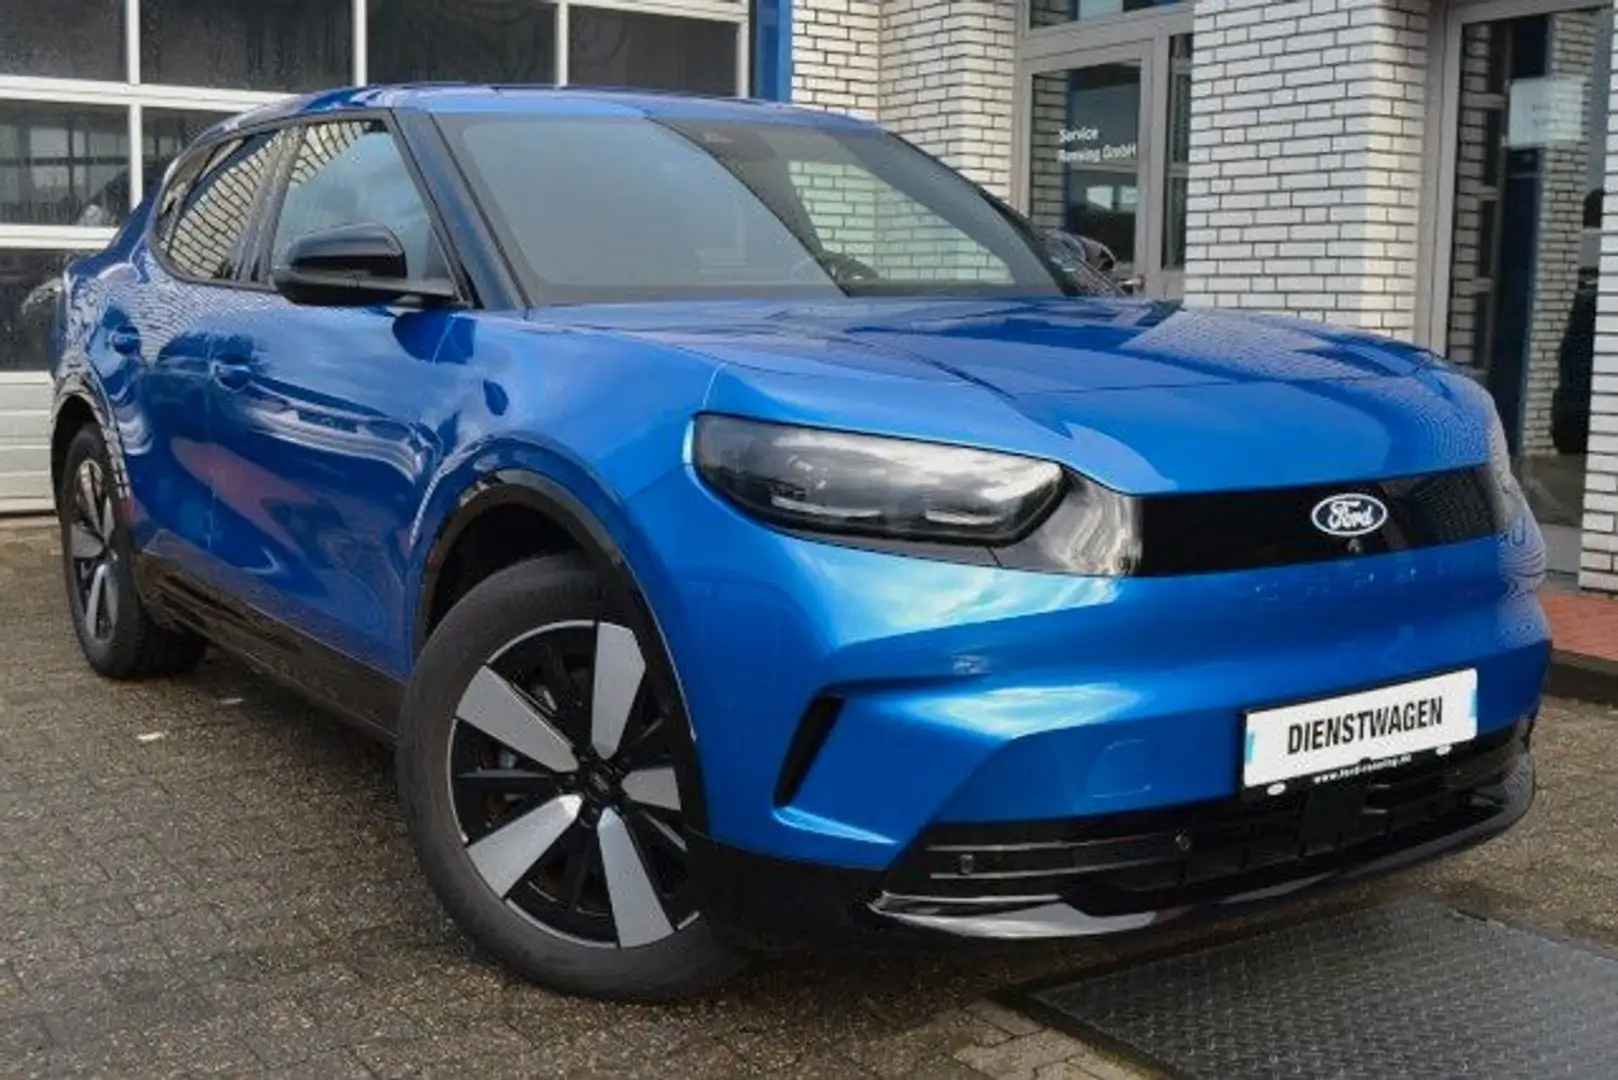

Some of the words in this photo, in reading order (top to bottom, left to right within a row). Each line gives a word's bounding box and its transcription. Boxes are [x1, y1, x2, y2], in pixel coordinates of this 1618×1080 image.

[1059, 125, 1098, 142] Service
[1102, 143, 1137, 160] GmbH
[1328, 500, 1374, 530] Ford
[1287, 696, 1443, 755] DIENSTWAGEN
